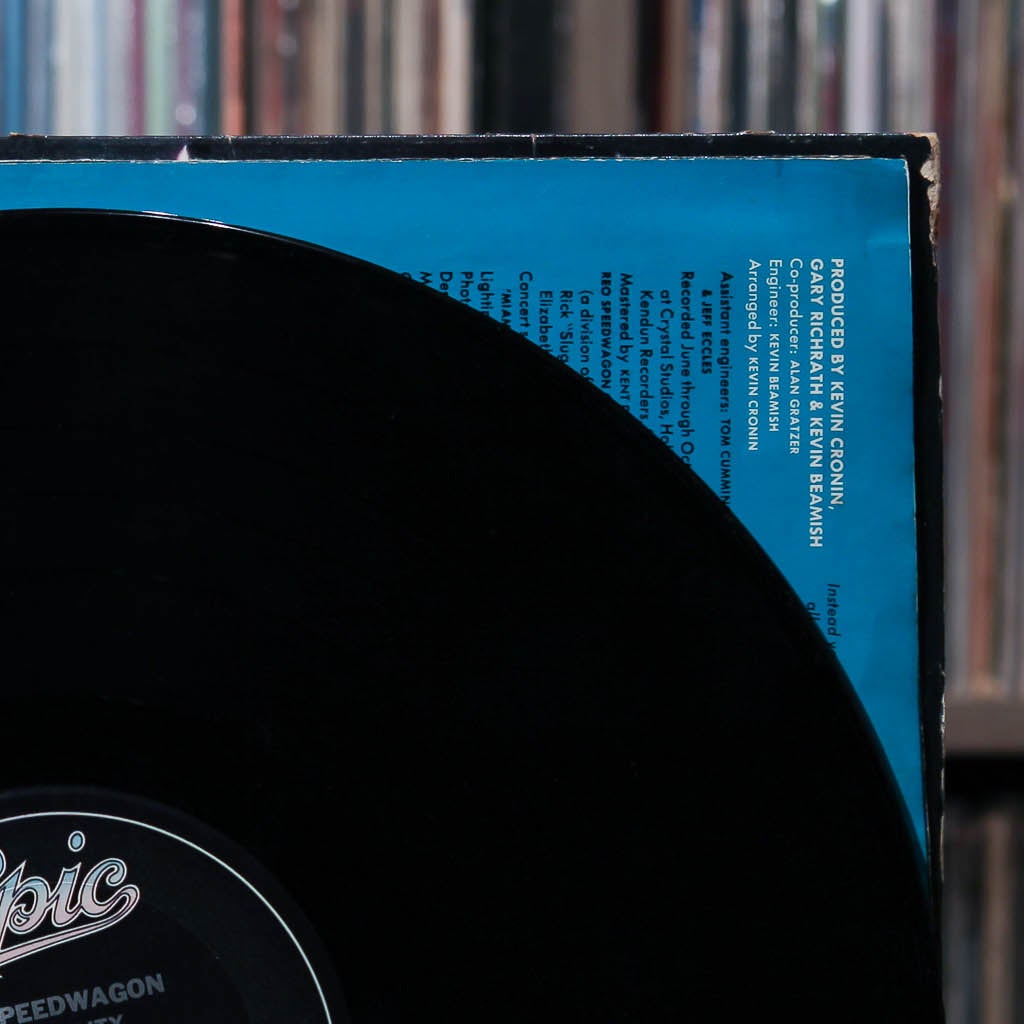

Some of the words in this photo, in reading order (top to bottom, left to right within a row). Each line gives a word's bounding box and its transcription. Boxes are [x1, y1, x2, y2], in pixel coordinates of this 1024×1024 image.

[601, 272, 611, 296] REO
[619, 273, 634, 340] Mastered
[660, 290, 672, 304] at
[681, 272, 695, 339] Recorded
[720, 272, 734, 334] Assistant
[745, 259, 762, 329] Arranged
[766, 260, 782, 327] Engineer:
[786, 258, 803, 353] Co-producer:
[811, 259, 823, 305] GARY
[831, 259, 844, 348] PRODUCED
[640, 290, 654, 344] Kendun
[656, 308, 674, 359] Crystal
[702, 302, 712, 326] JEFF
[616, 345, 634, 362] by
[681, 344, 694, 377] June
[701, 332, 712, 374] ECCLES
[744, 335, 762, 352] by
[769, 334, 779, 371] KEVIN
[810, 312, 823, 394] RICHRATH
[831, 355, 844, 375] BY
[620, 370, 630, 400] KENT
[658, 364, 674, 419] Studios,
[717, 339, 732, 412] engineers:
[749, 358, 758, 395] KEVIN
[790, 360, 800, 394] ALAN
[678, 381, 695, 437] through
[748, 401, 758, 450] CRONIN
[769, 377, 779, 431] BEAMISH
[790, 399, 800, 454] GRATZER
[810, 401, 823, 410] &
[831, 382, 844, 431] KEVIN
[720, 419, 731, 446] TOM
[810, 418, 823, 467] KEVIN
[828, 438, 843, 509] CRONIN,
[809, 474, 823, 546] BEAMISH
